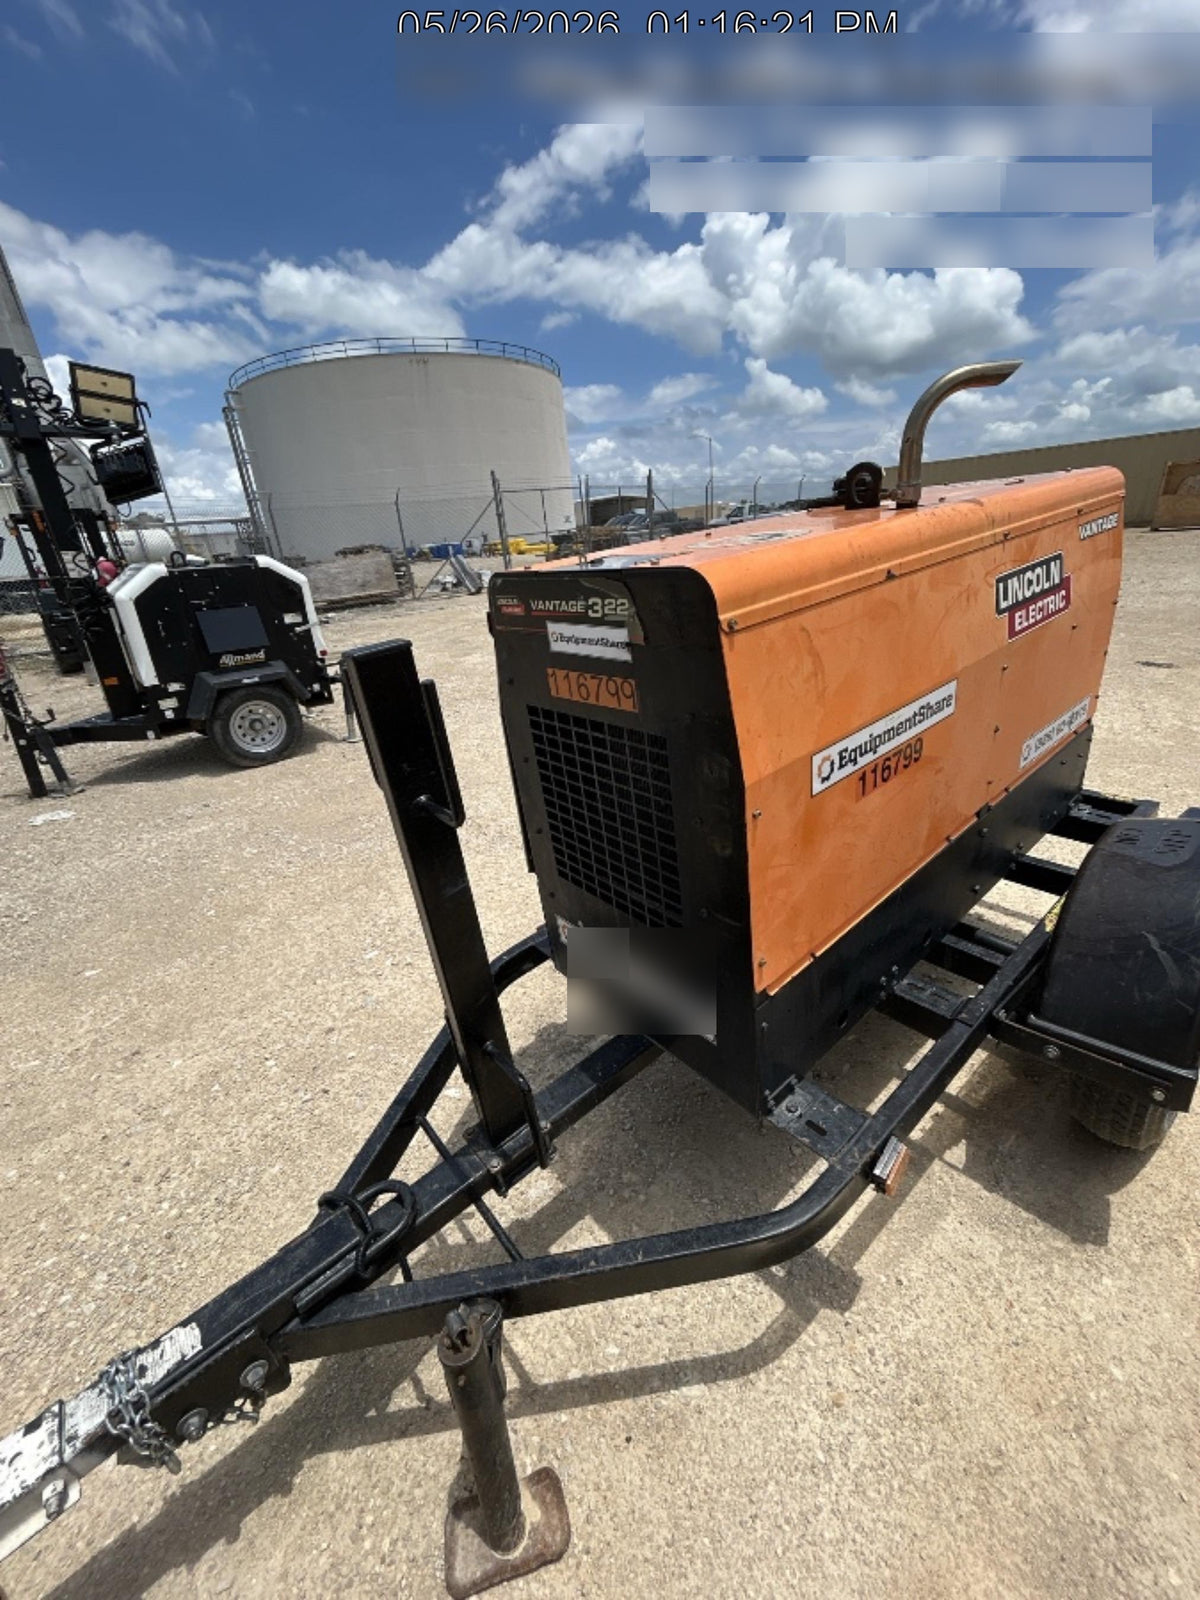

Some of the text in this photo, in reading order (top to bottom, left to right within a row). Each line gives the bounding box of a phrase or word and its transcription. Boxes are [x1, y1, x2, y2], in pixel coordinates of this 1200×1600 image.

[1078, 513, 1120, 540] VANTAGE
[998, 559, 1062, 610] LINCOLN
[529, 597, 629, 618] VANTAGE 322
[1014, 589, 1067, 632] ELECTRIC
[550, 669, 637, 709] 116799
[837, 693, 954, 771] EquipmentShare
[858, 737, 924, 797] 116799
